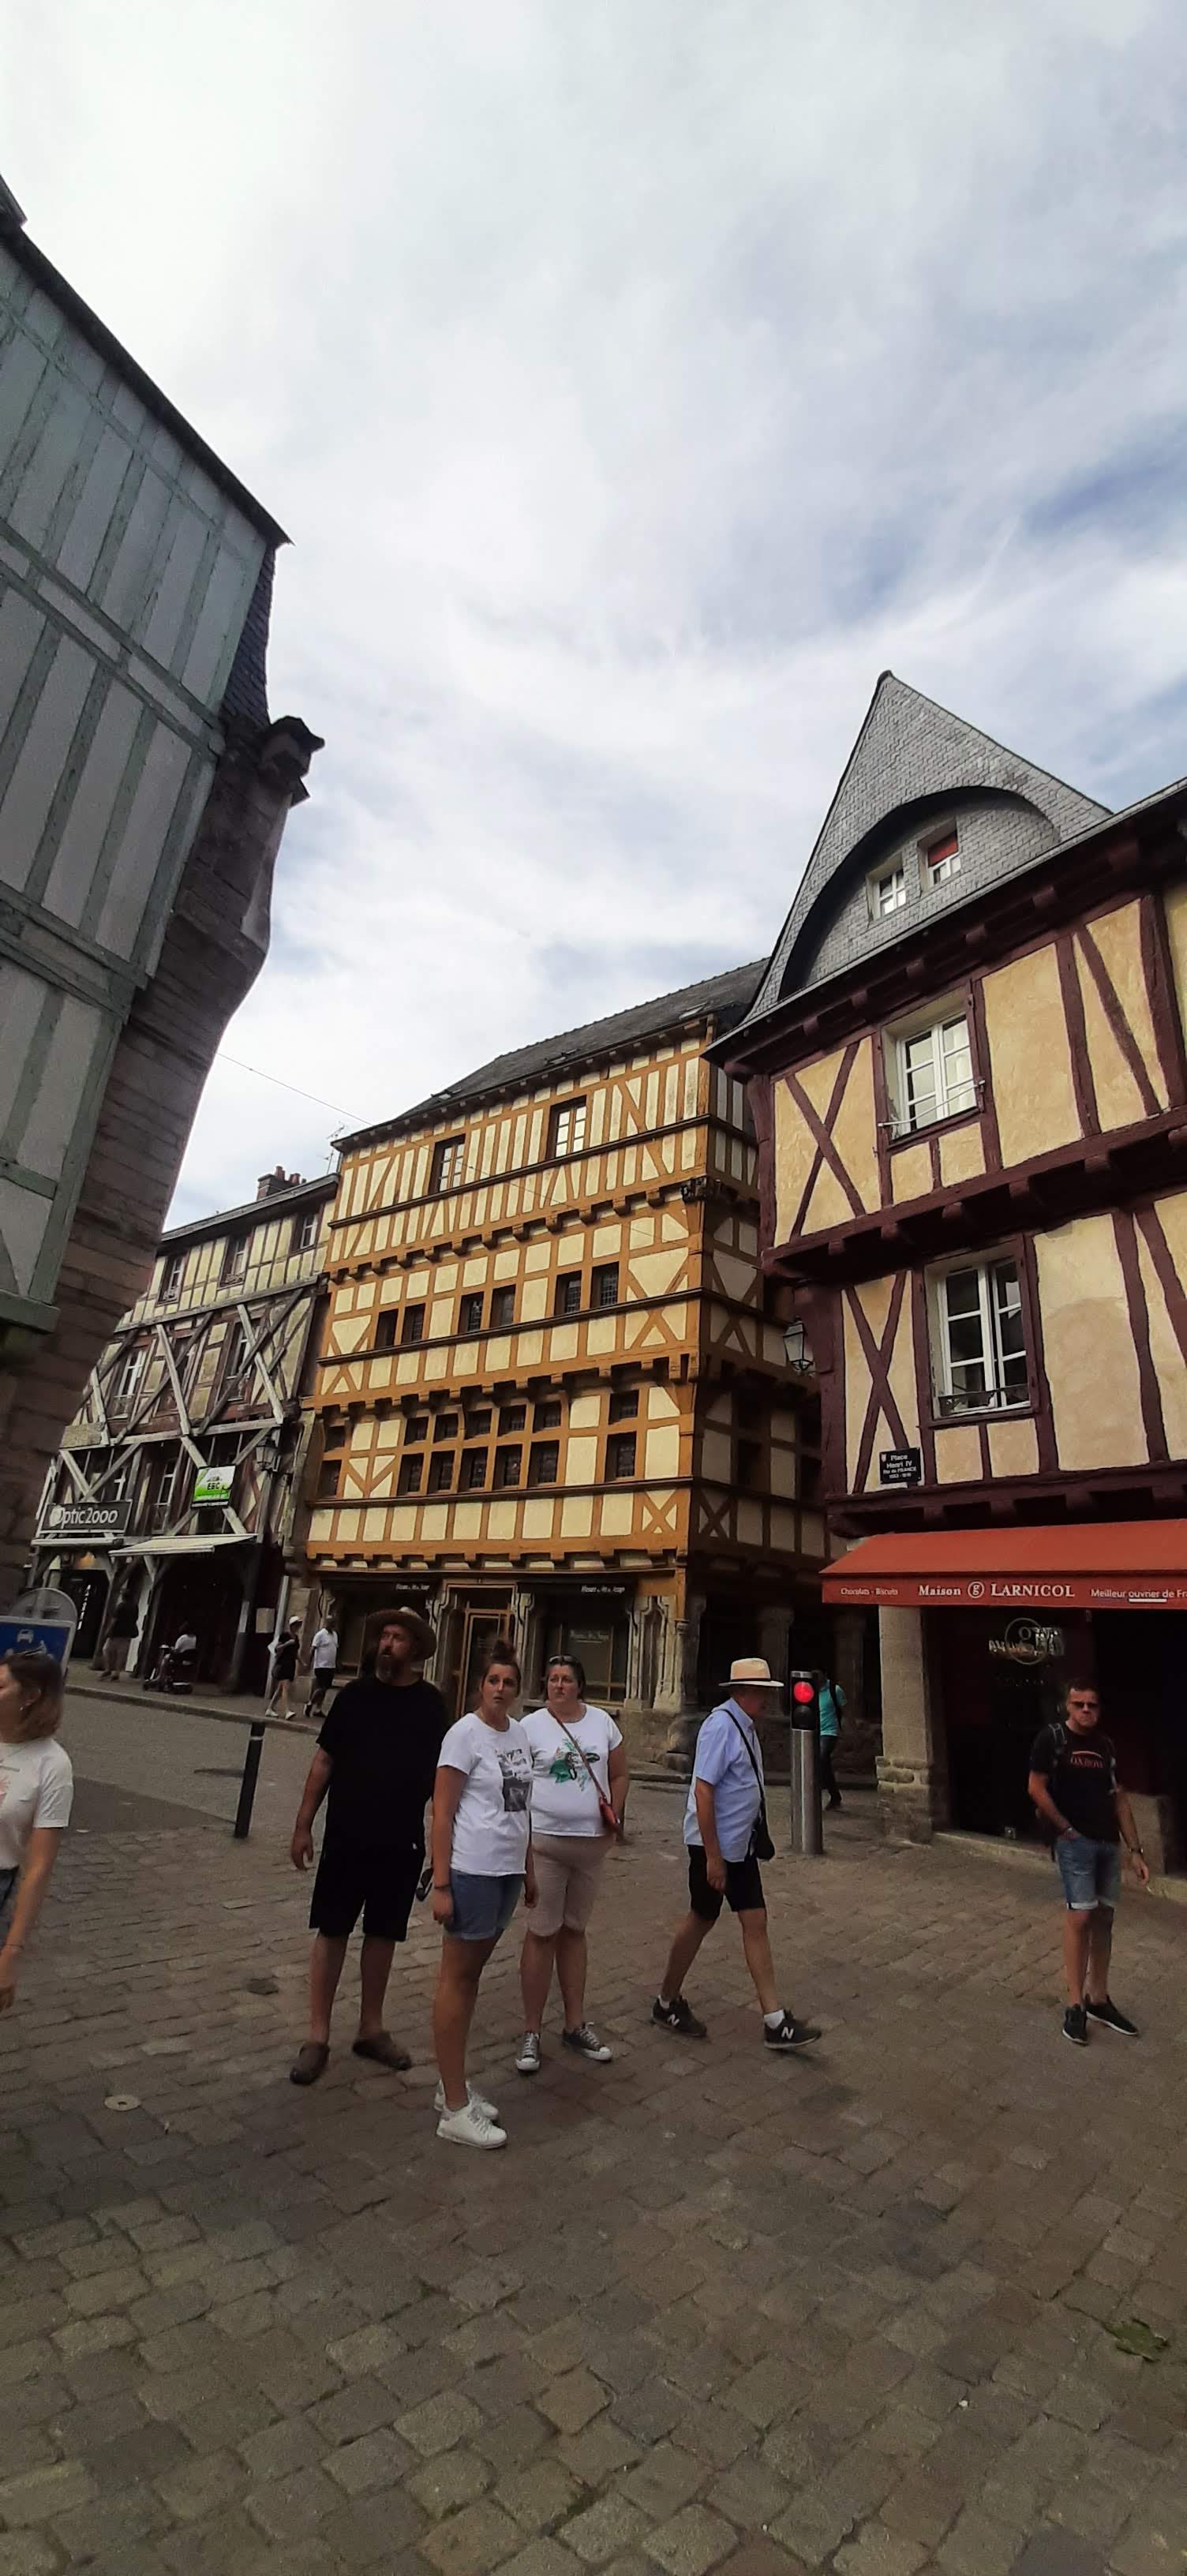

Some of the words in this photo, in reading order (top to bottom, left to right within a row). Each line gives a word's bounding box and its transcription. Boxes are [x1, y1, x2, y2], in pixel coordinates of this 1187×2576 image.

[919, 1585, 961, 1596] Maison
[990, 1583, 1075, 1597] LARNICOL
[1091, 1588, 1126, 1597] Meilleur
[1129, 1589, 1160, 1598] ouvrier
[1162, 1589, 1175, 1598] de
[668, 2014, 680, 2026] N
[781, 2026, 794, 2039] N
